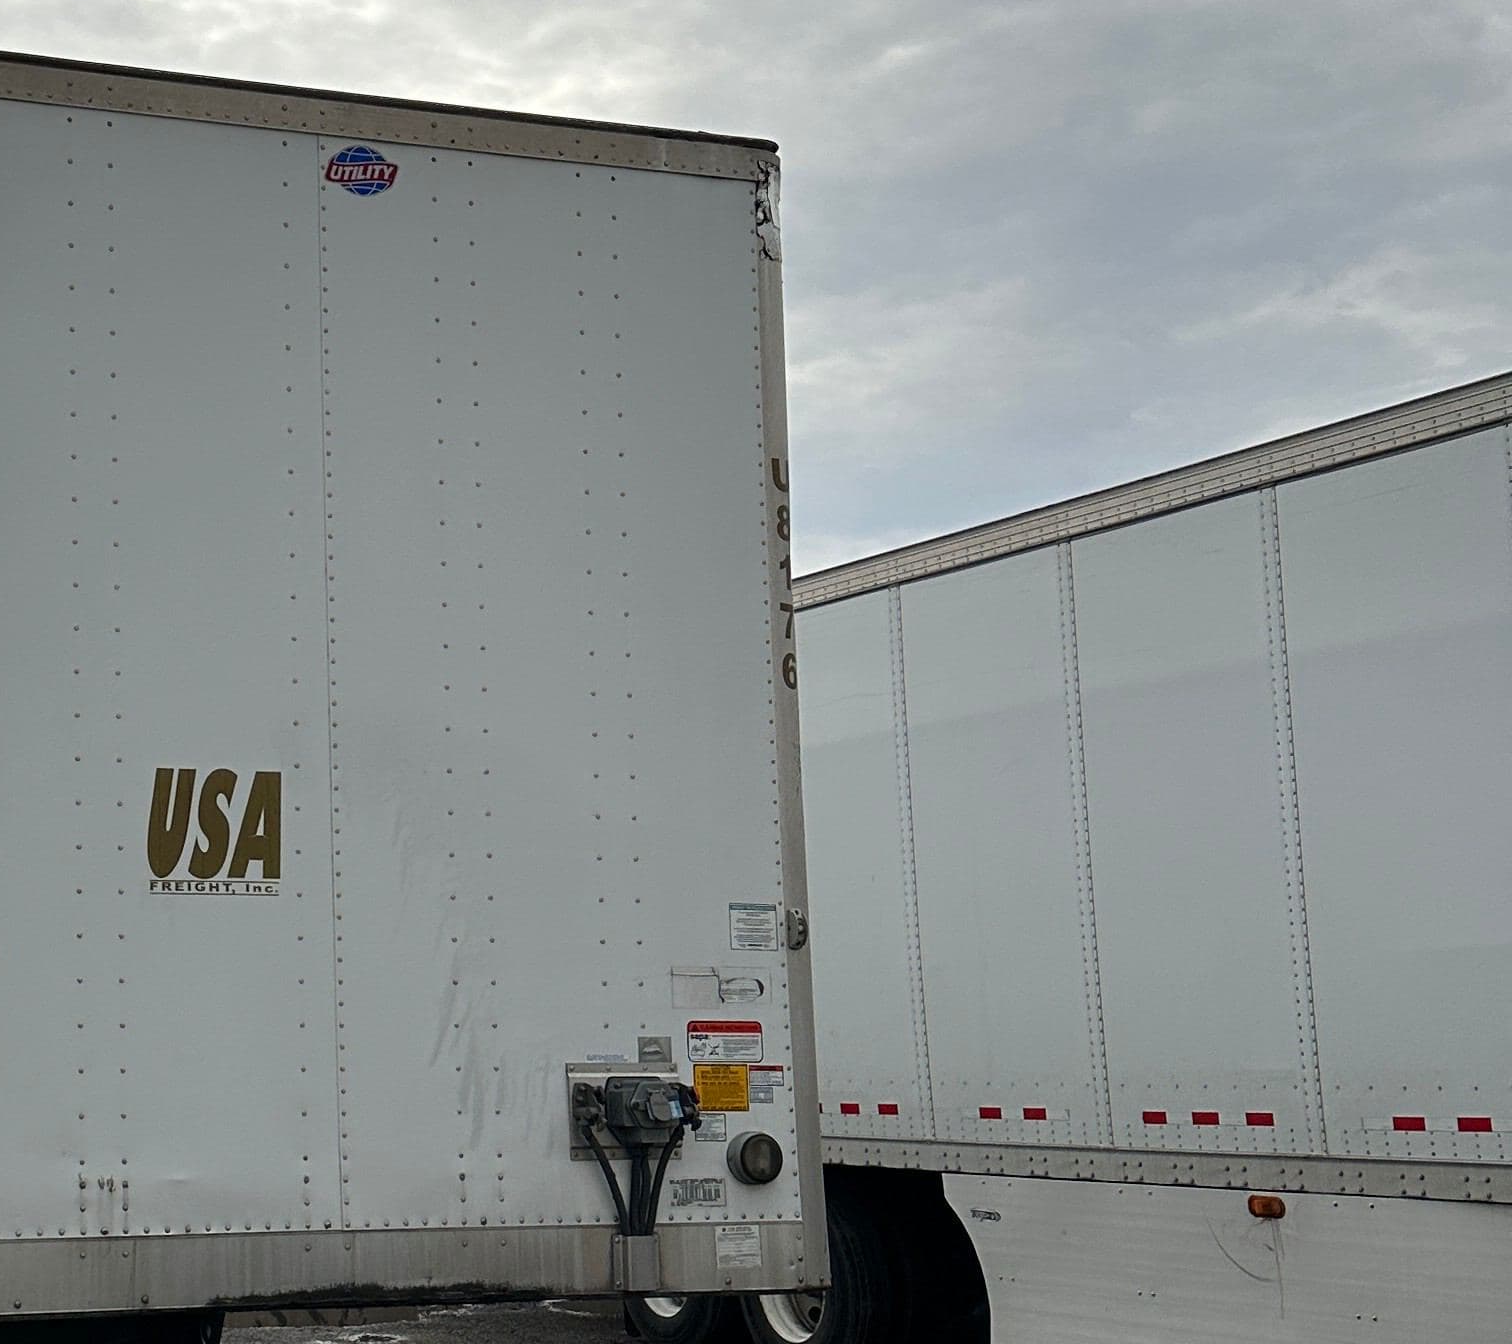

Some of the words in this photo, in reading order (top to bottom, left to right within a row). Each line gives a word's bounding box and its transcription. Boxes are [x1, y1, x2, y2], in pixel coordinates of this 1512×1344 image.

[332, 165, 394, 180] UTILITY
[147, 767, 282, 879] USA
[149, 881, 236, 895] FREIGHT,
[245, 883, 279, 894] Inc.
